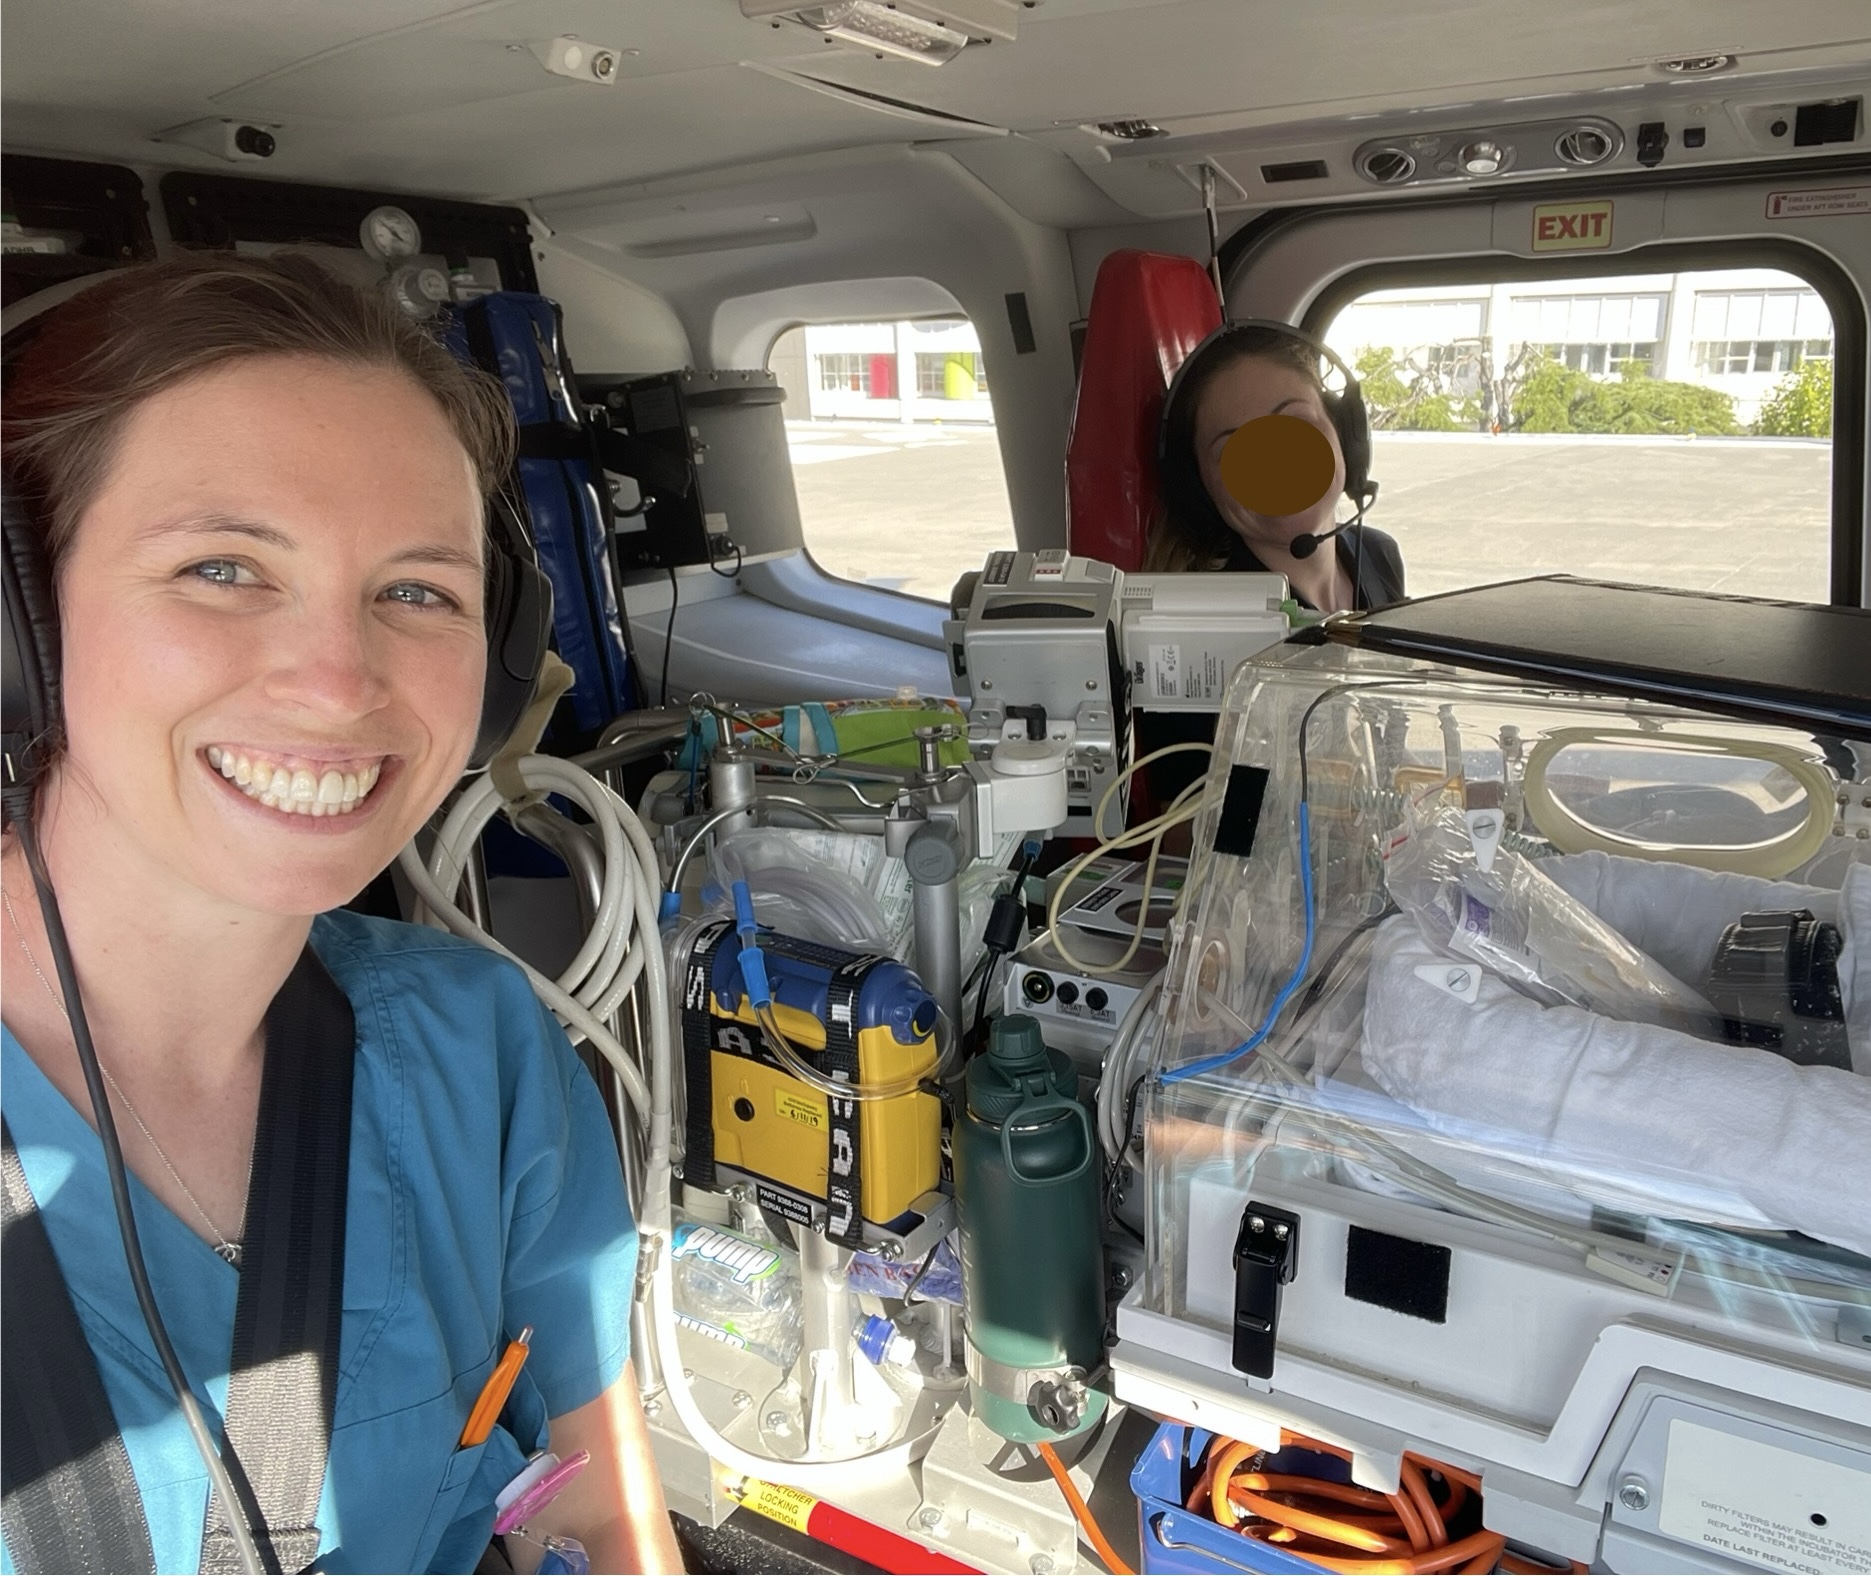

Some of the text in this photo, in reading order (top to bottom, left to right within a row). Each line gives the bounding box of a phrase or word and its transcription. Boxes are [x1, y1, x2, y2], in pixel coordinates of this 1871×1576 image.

[1538, 212, 1608, 241] EXIT
[1134, 661, 1145, 684] Dräger
[760, 1188, 776, 1200] PART
[761, 1199, 783, 1214] SERIAL
[757, 1502, 797, 1527] POSITION
[760, 1491, 799, 1515] LOCKING
[1701, 1500, 1729, 1514] DIRTY
[1731, 1509, 1770, 1527] FILTERS
[1772, 1522, 1793, 1534] MAY
[1795, 1529, 1833, 1546] RESULT
[1835, 1541, 1847, 1550] IN
[1703, 1533, 1731, 1548] DATE
[1733, 1543, 1761, 1557] LAST
[1707, 1518, 1870, 1574] REPLACE FILTER AT LEAST EVERY
[1740, 1520, 1775, 1536] WITHIN
[1778, 1532, 1796, 1543] THE
[1799, 1538, 1857, 1562] INCUBATOR
